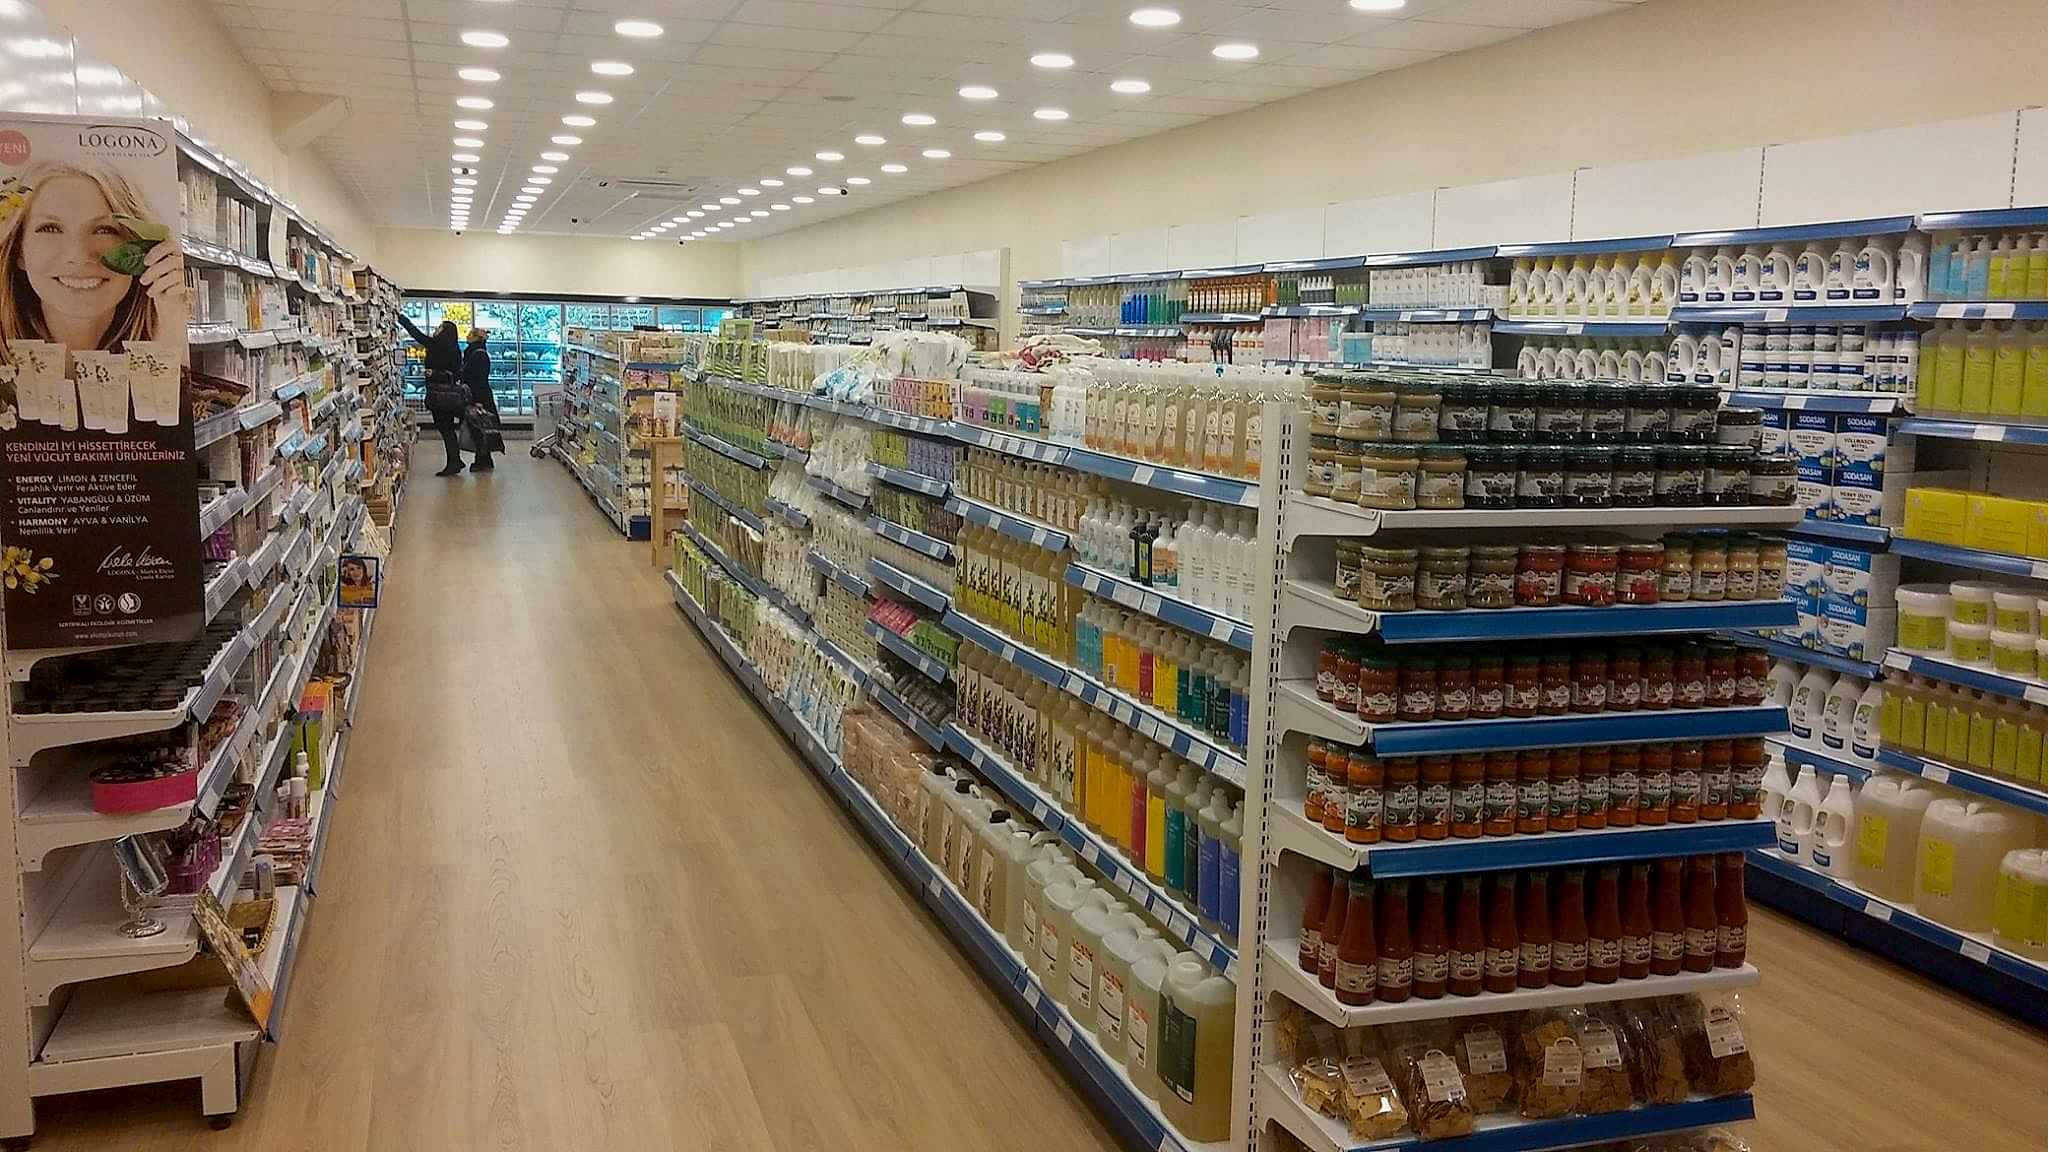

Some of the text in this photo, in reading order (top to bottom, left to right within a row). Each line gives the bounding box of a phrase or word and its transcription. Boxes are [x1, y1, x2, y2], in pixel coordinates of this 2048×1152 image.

[78, 133, 158, 149] LOGONA
[1799, 415, 1826, 425] SODASAN
[1847, 417, 1876, 427] SODASAN
[5, 440, 157, 451] KENDİNİZİ İYİ HİSSETTİRECEK
[6, 450, 185, 462] YENİ VÜCUT BAKIMI ÜRÜNLERİNİZ
[1798, 467, 1822, 476] ODASAN
[1843, 471, 1872, 481] SODASAN
[16, 475, 53, 483] ENERGY
[18, 518, 68, 526] HARMONY
[73, 517, 99, 525] AYVA
[1832, 550, 1860, 562] SODASAN
[1828, 603, 1857, 616] SODASAN
